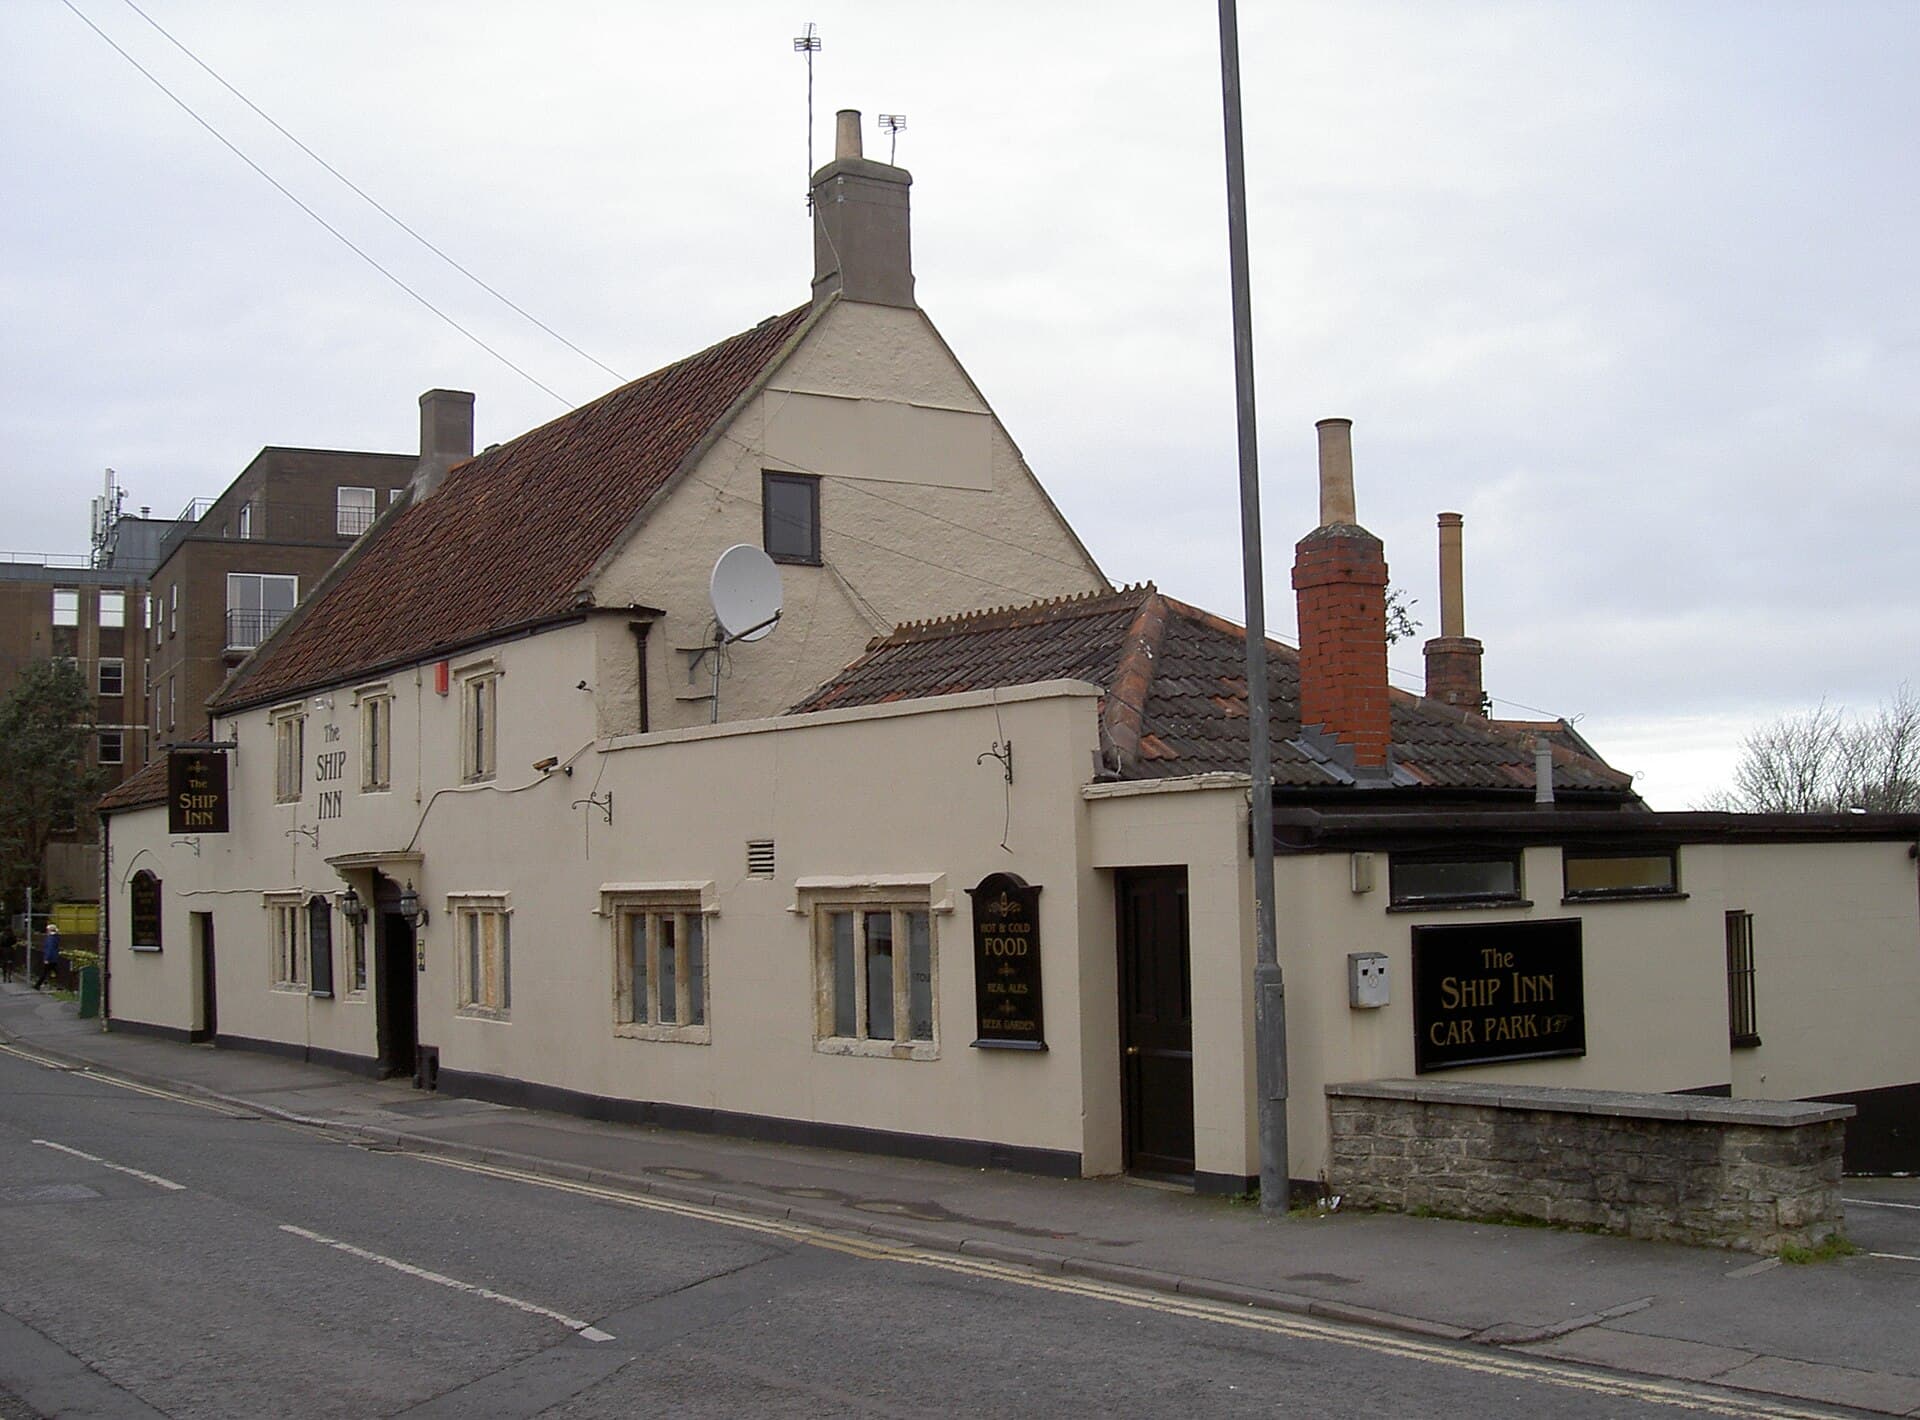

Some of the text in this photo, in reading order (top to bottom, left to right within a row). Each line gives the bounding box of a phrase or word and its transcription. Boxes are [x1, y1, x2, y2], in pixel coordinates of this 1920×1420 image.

[323, 723, 341, 743] The
[316, 751, 347, 782] SHIP
[190, 779, 208, 789] The
[179, 793, 218, 809] SHIP
[318, 790, 343, 820] INN
[185, 811, 214, 825] INN
[980, 923, 997, 933] HOT
[1008, 922, 1031, 933] COLD
[984, 938, 1028, 956] FOOD
[1481, 947, 1514, 969] The
[1008, 983, 1028, 994] ALES
[1441, 971, 1555, 1010] SHIP INN
[1430, 1014, 1540, 1047] CAR PARK
